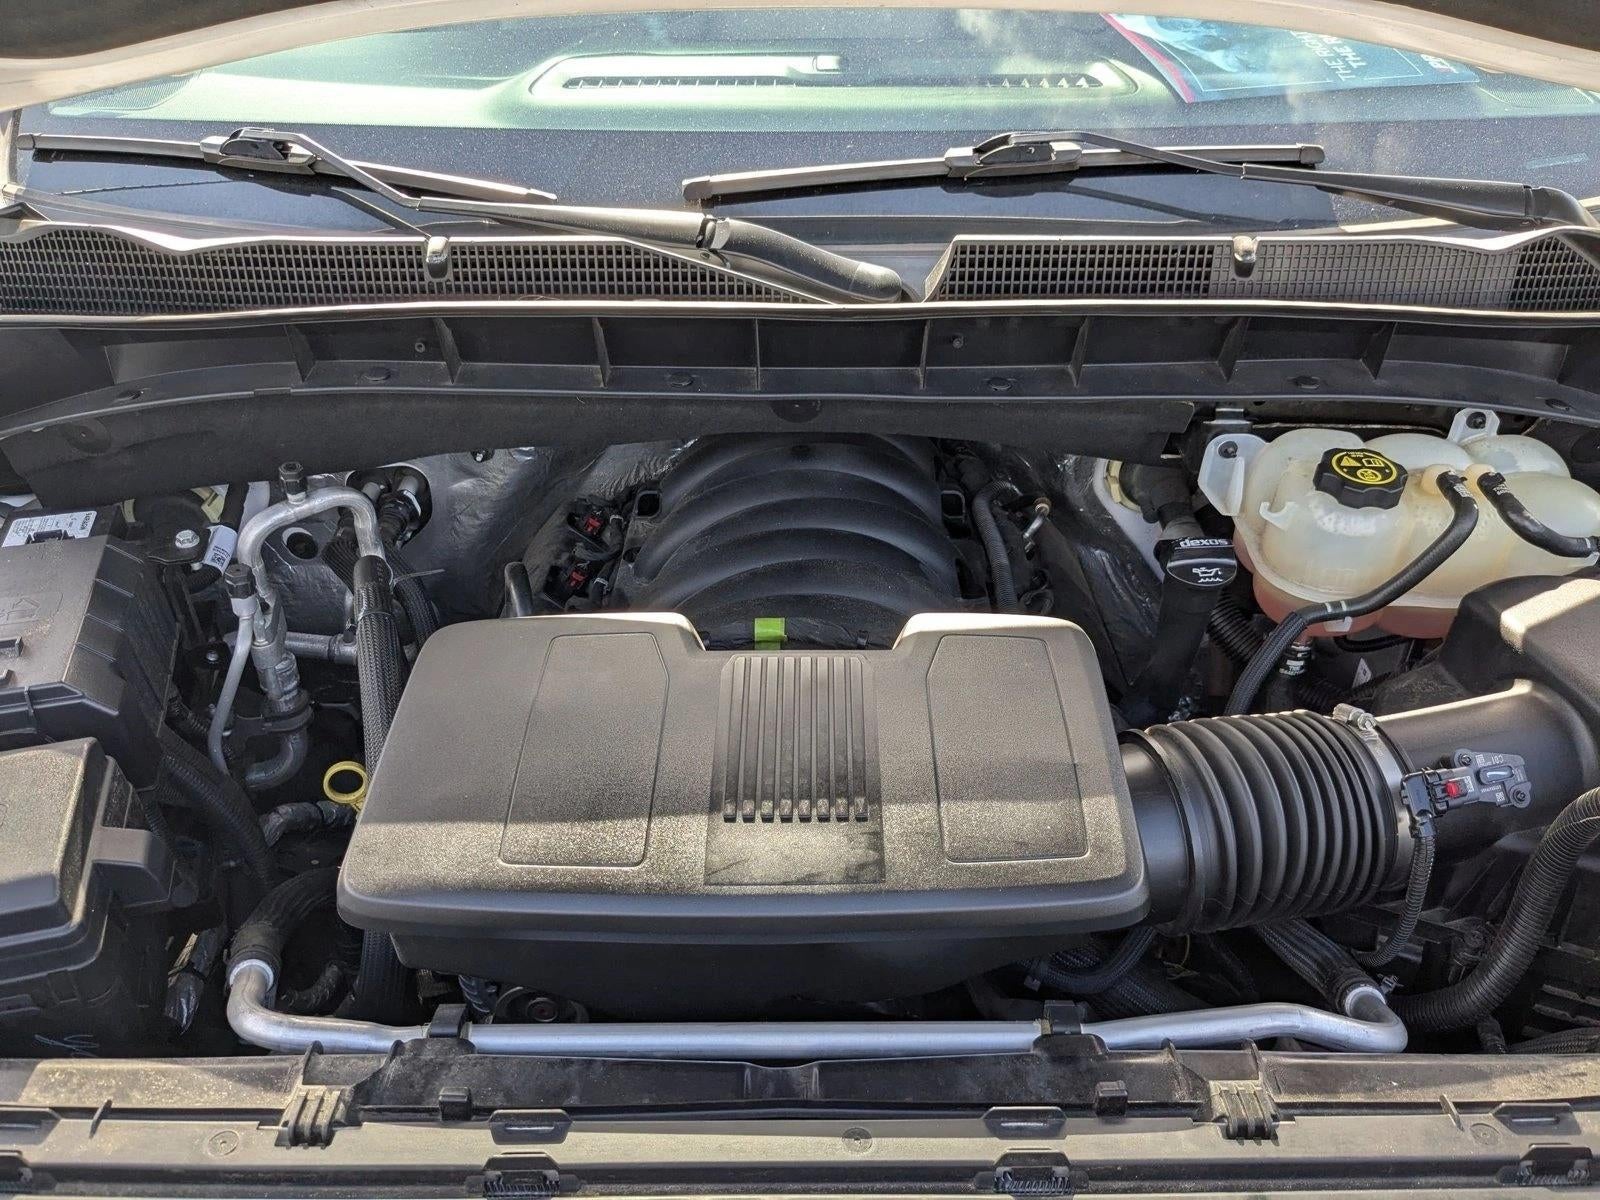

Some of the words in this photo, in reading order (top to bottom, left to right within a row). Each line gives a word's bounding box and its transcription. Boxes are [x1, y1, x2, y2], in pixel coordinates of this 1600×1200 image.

[1332, 46, 1367, 68] THE
[1323, 58, 1356, 82] THE
[1179, 537, 1229, 547] dexos
